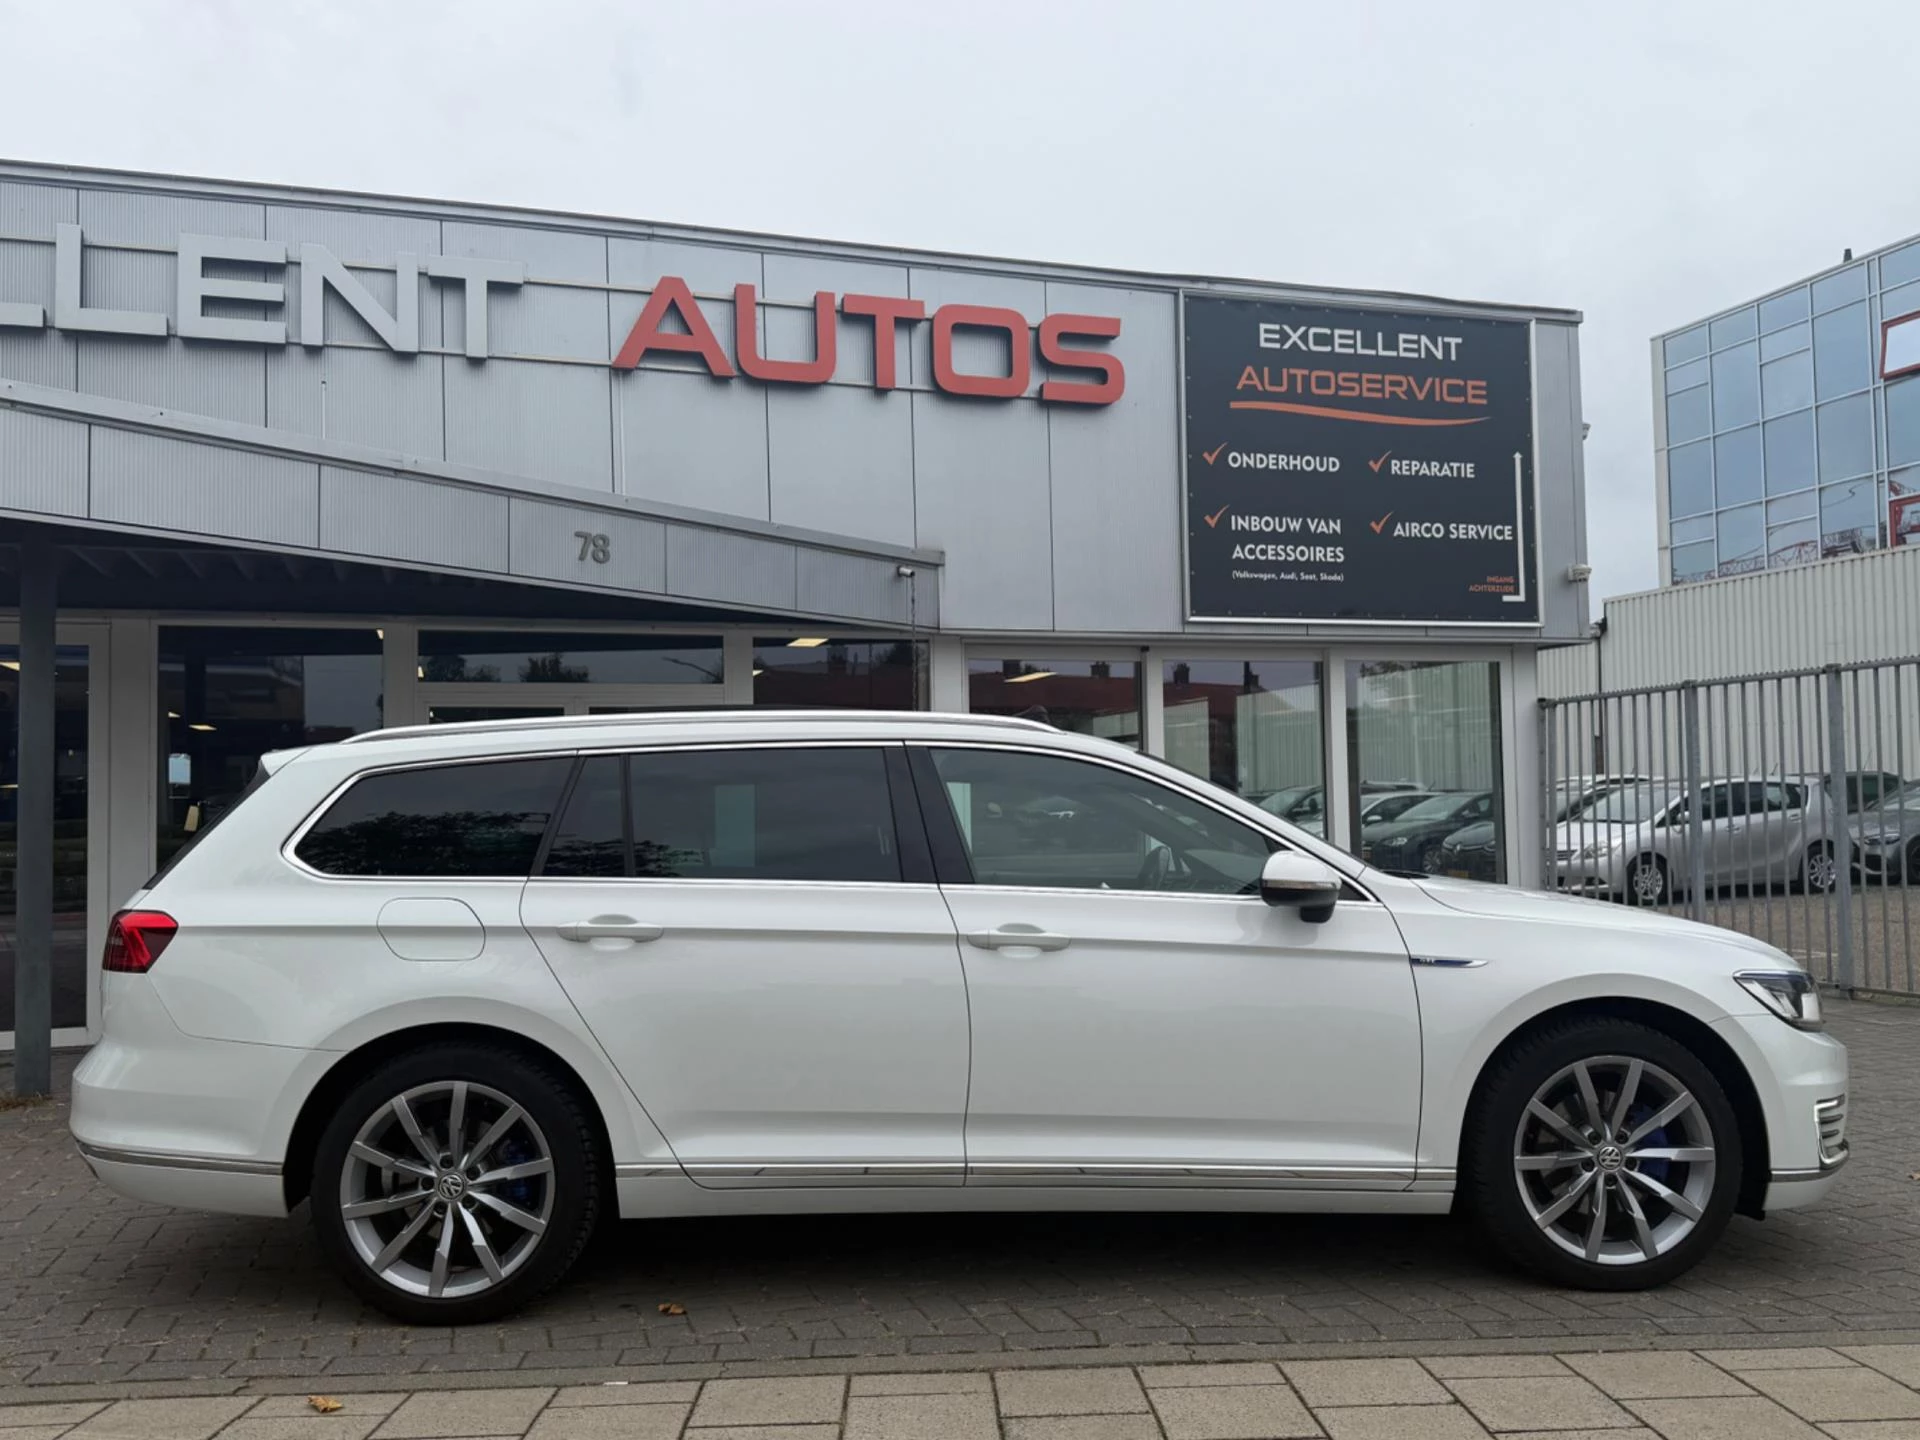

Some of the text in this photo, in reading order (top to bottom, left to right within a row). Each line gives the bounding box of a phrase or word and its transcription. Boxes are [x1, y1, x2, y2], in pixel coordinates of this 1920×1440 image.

[0, 223, 1125, 404] LENT AUTOS
[1258, 322, 1463, 361] EXCELLENT
[1236, 365, 1488, 405] AUTOSERVICE
[1227, 451, 1340, 472] ONDERHOUD
[1390, 459, 1476, 479] REPARATIE
[1231, 515, 1342, 535] INBOUW VAN
[1393, 522, 1514, 541] AIRCO SERVICE
[574, 531, 611, 564] 78
[1232, 543, 1345, 563] ACCESSOIRES
